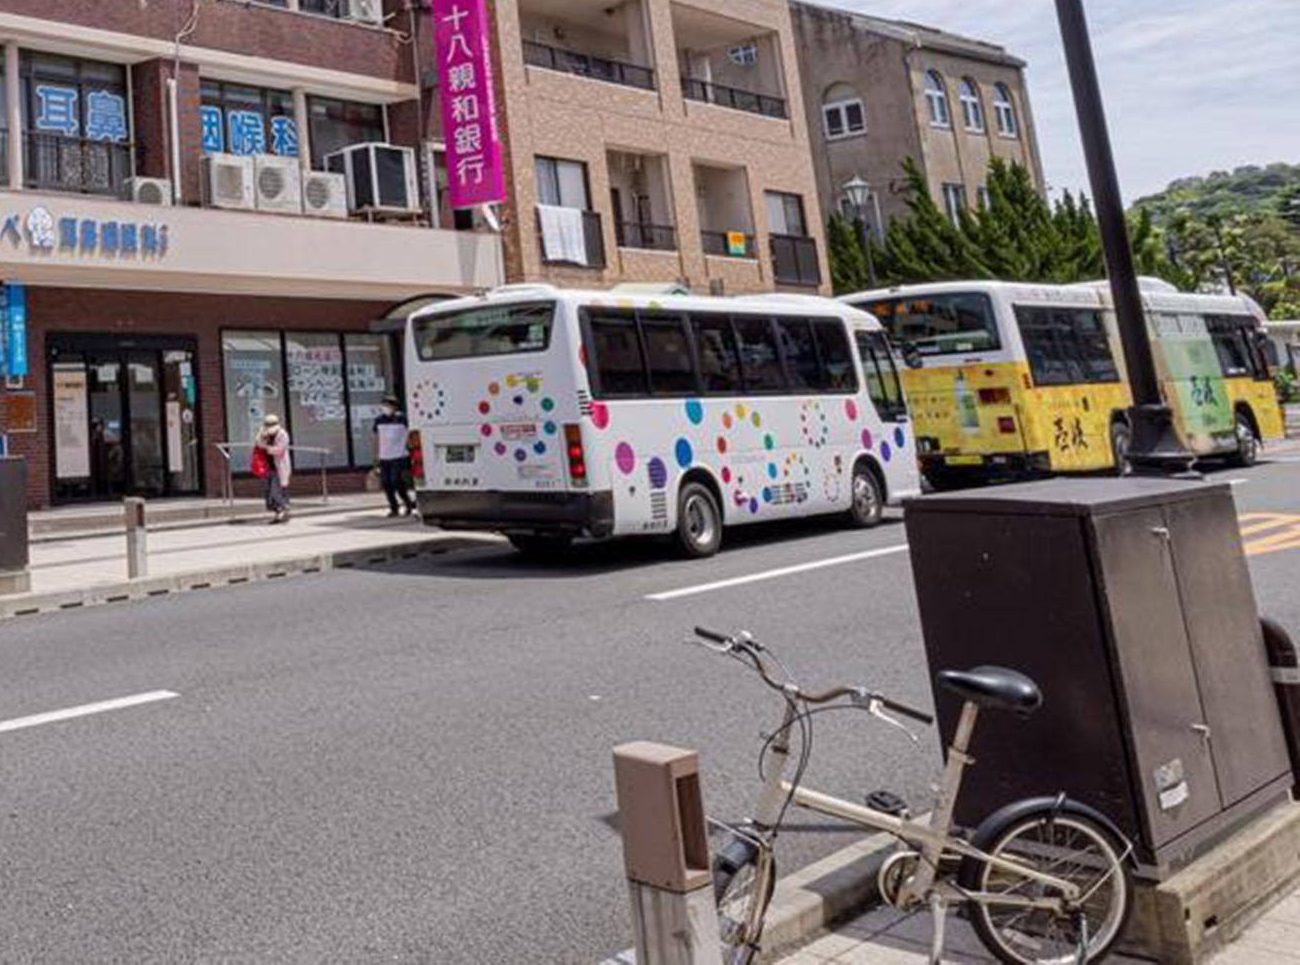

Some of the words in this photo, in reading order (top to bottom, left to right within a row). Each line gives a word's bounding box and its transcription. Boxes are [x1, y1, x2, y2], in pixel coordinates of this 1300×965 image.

[35, 85, 128, 144] 耳鼻
[442, 4, 485, 185] 十八親和銀行
